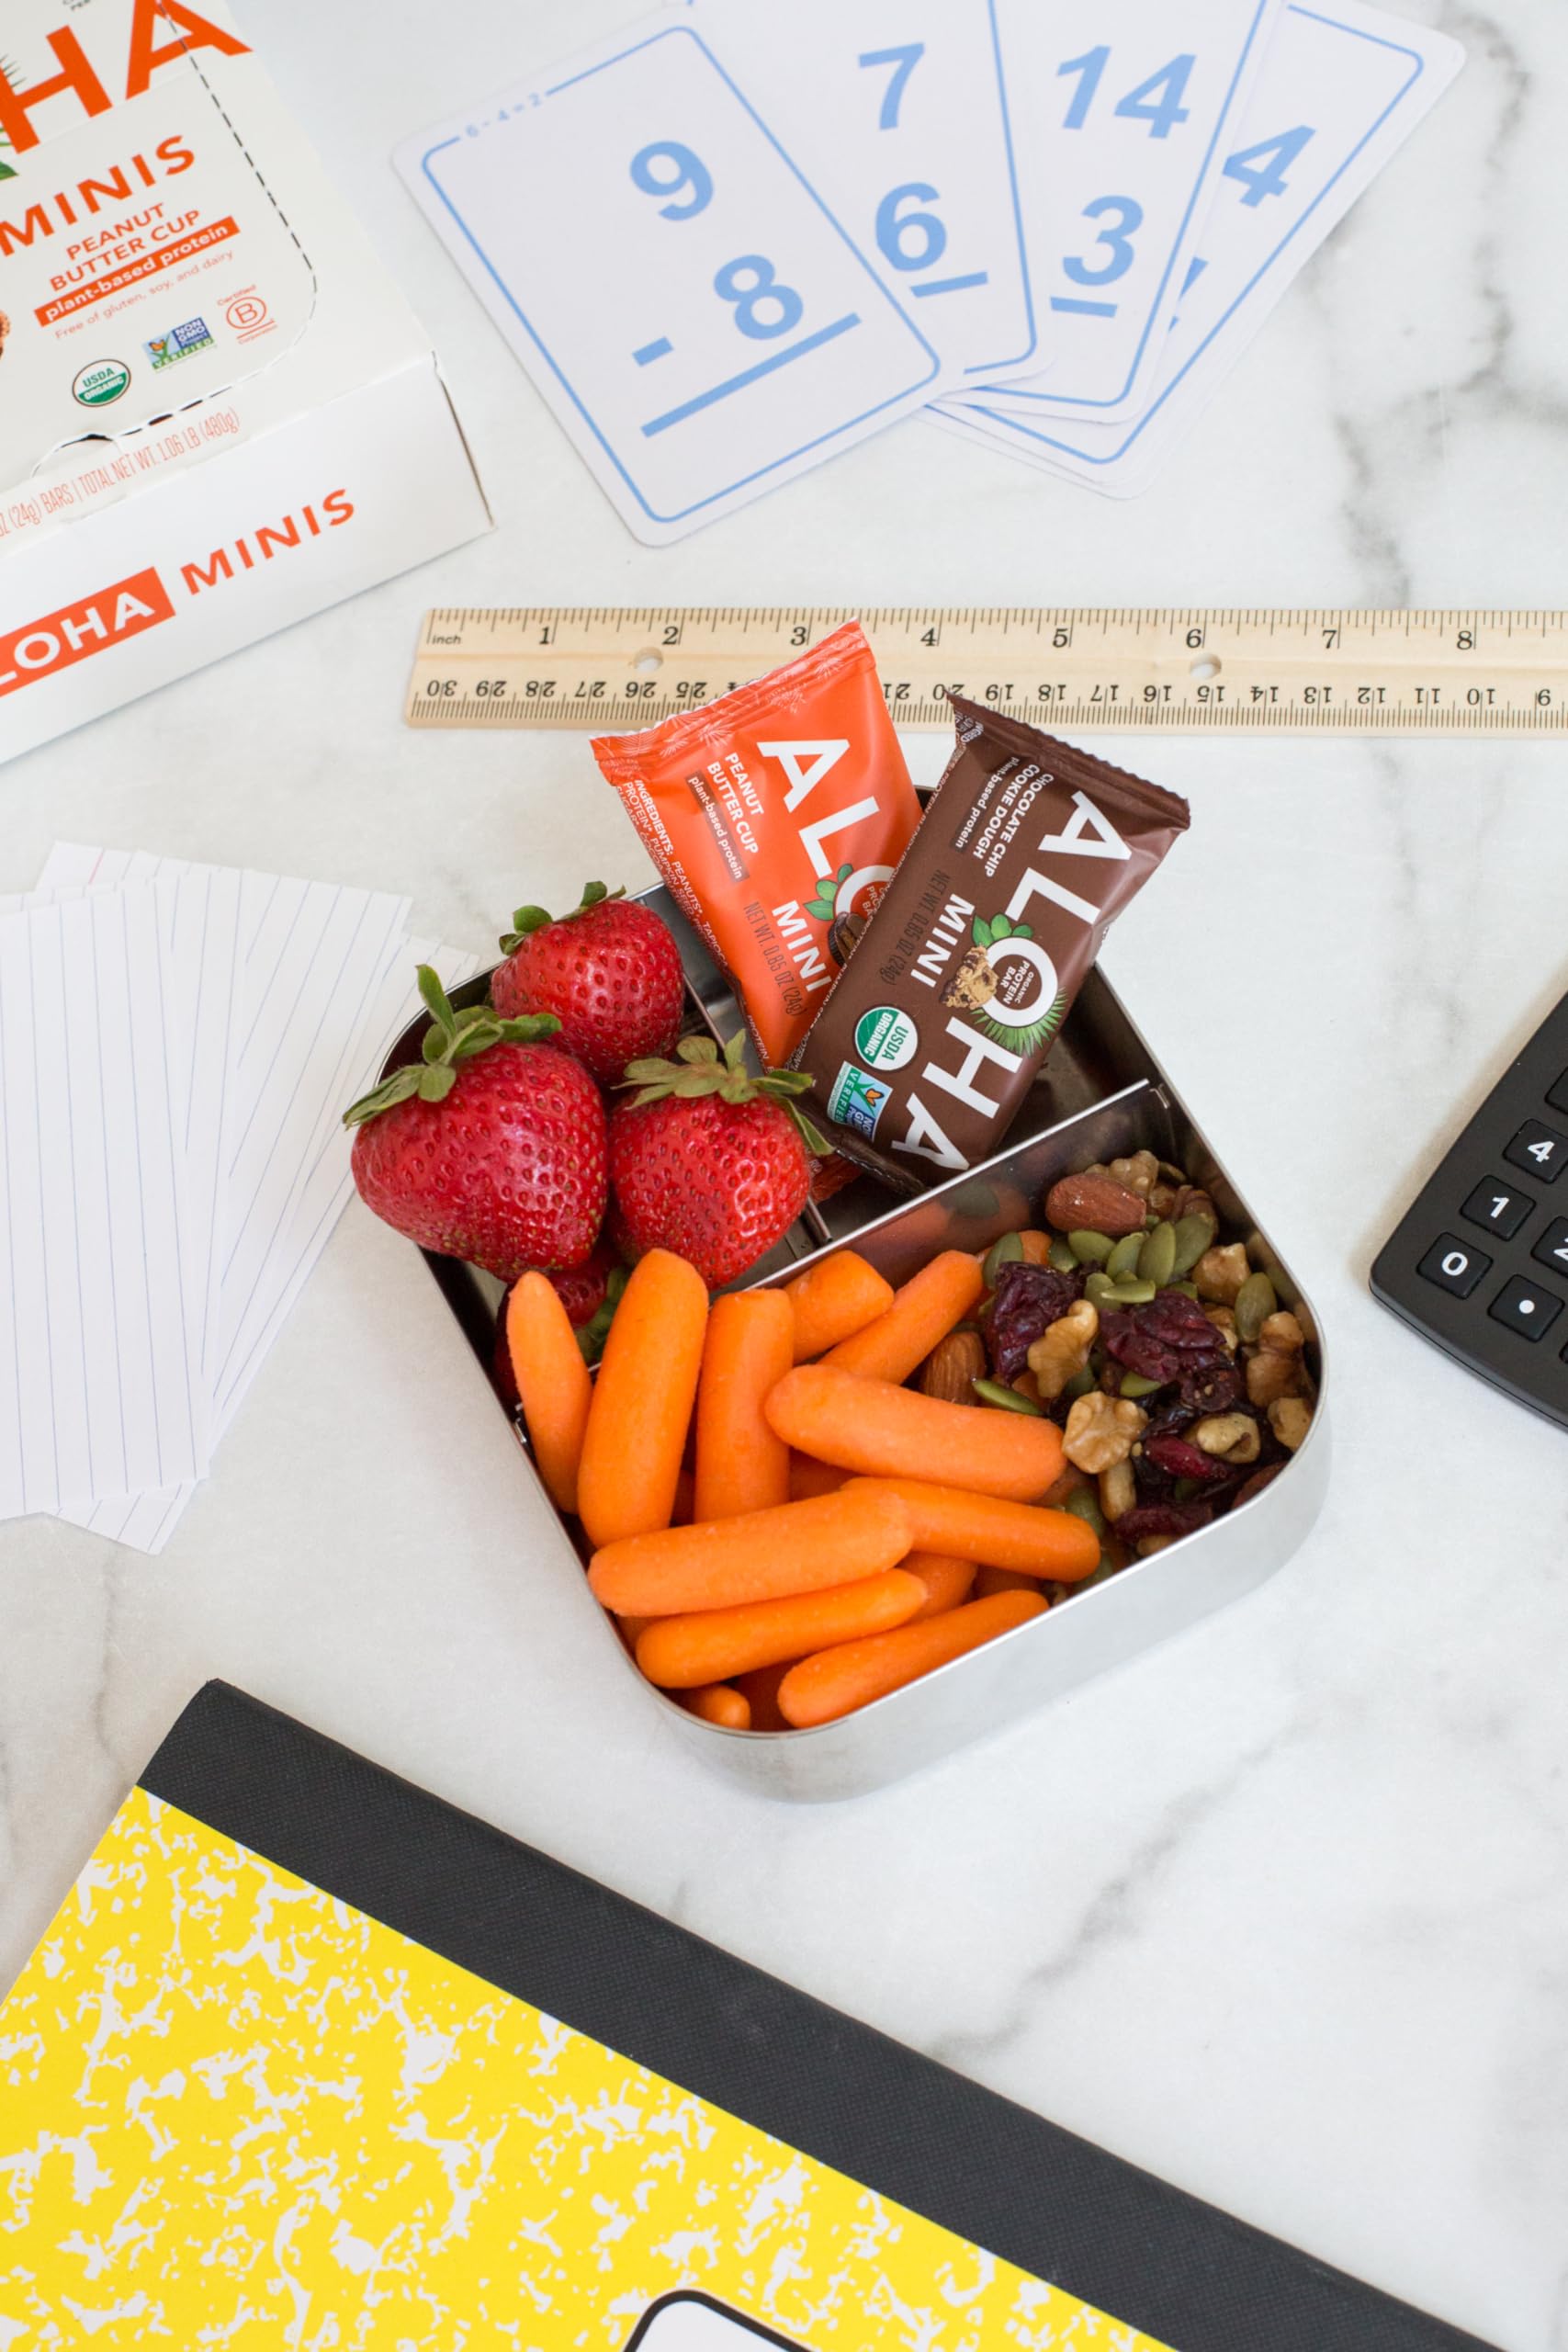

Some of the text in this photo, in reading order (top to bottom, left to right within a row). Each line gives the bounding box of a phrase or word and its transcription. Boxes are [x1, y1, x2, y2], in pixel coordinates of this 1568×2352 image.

[858, 42, 926, 130] 7
[1055, 46, 1197, 139] 14
[629, 141, 715, 221] 9
[1222, 124, 1316, 209] 4
[0, 135, 196, 257] MINIS
[66, 202, 166, 261] PEANUT
[874, 182, 947, 272] 6
[1062, 195, 1145, 286] 3
[50, 209, 201, 293] BUTTER CUP
[44, 221, 230, 322] plant-based protein
[54, 321, 85, 341] Free
[86, 311, 100, 325] of
[103, 292, 148, 320] gluten,
[175, 263, 200, 283] and
[202, 250, 234, 271] dairy
[713, 254, 805, 341] 8
[174, 319, 202, 337] NON
[234, 302, 258, 324] B
[177, 325, 207, 343] GMO
[82, 367, 116, 388] USDA
[83, 376, 125, 401] ORGANIC
[8, 499, 42, 529] (24g)
[39, 483, 75, 514] BARS
[78, 464, 116, 496] TOTAL
[110, 452, 137, 481] NET
[183, 426, 202, 451] LB
[199, 407, 242, 440] (480g)
[180, 489, 355, 596] MINIS
[431, 627, 1473, 650] inch 1 2 3 4 5 6 7 8
[427, 680, 457, 699] 30
[475, 680, 506, 699] 29
[525, 681, 556, 700] 28
[574, 681, 606, 700] 27
[625, 682, 657, 701] 26
[676, 682, 707, 701] 25
[986, 684, 1014, 703] 19
[1038, 684, 1066, 704] 18
[1090, 685, 1120, 704] 17
[1144, 685, 1172, 705] 16
[1197, 686, 1226, 705] 15
[1250, 686, 1280, 705] 14
[1303, 686, 1333, 706] 13
[1358, 687, 1387, 706] 12
[1415, 687, 1441, 707] 11
[1467, 688, 1497, 707] 10
[725, 752, 765, 817] PEANUT
[634, 779, 674, 855] INGREDIENTS:
[706, 761, 759, 854] BUTTER CUP
[954, 756, 1021, 850] plant-based protein
[973, 763, 1041, 859] COOKIE DOUGH
[688, 775, 742, 879] plant-based protein
[984, 773, 1055, 878] CHOCOLATE CHIP
[930, 868, 952, 896] NET
[743, 900, 764, 926] NET
[772, 899, 832, 992] MINI
[896, 939, 917, 956] OZ
[910, 893, 976, 989] MINI
[762, 944, 788, 974] 0.85
[879, 954, 908, 986] (24g)
[773, 970, 795, 989] OZ
[891, 790, 1133, 1170] ALOHA
[1000, 966, 1017, 989] BAR
[1002, 959, 1031, 1004] PROTEIN
[1014, 971, 1035, 1004] ORGANIC
[783, 986, 808, 1017] (24g)
[863, 1012, 894, 1057] ORGANIC
[881, 1024, 909, 1061] USDA
[1527, 1140, 1555, 1163] 4
[1488, 1196, 1510, 1219] 1
[1440, 1251, 1469, 1277] 0
